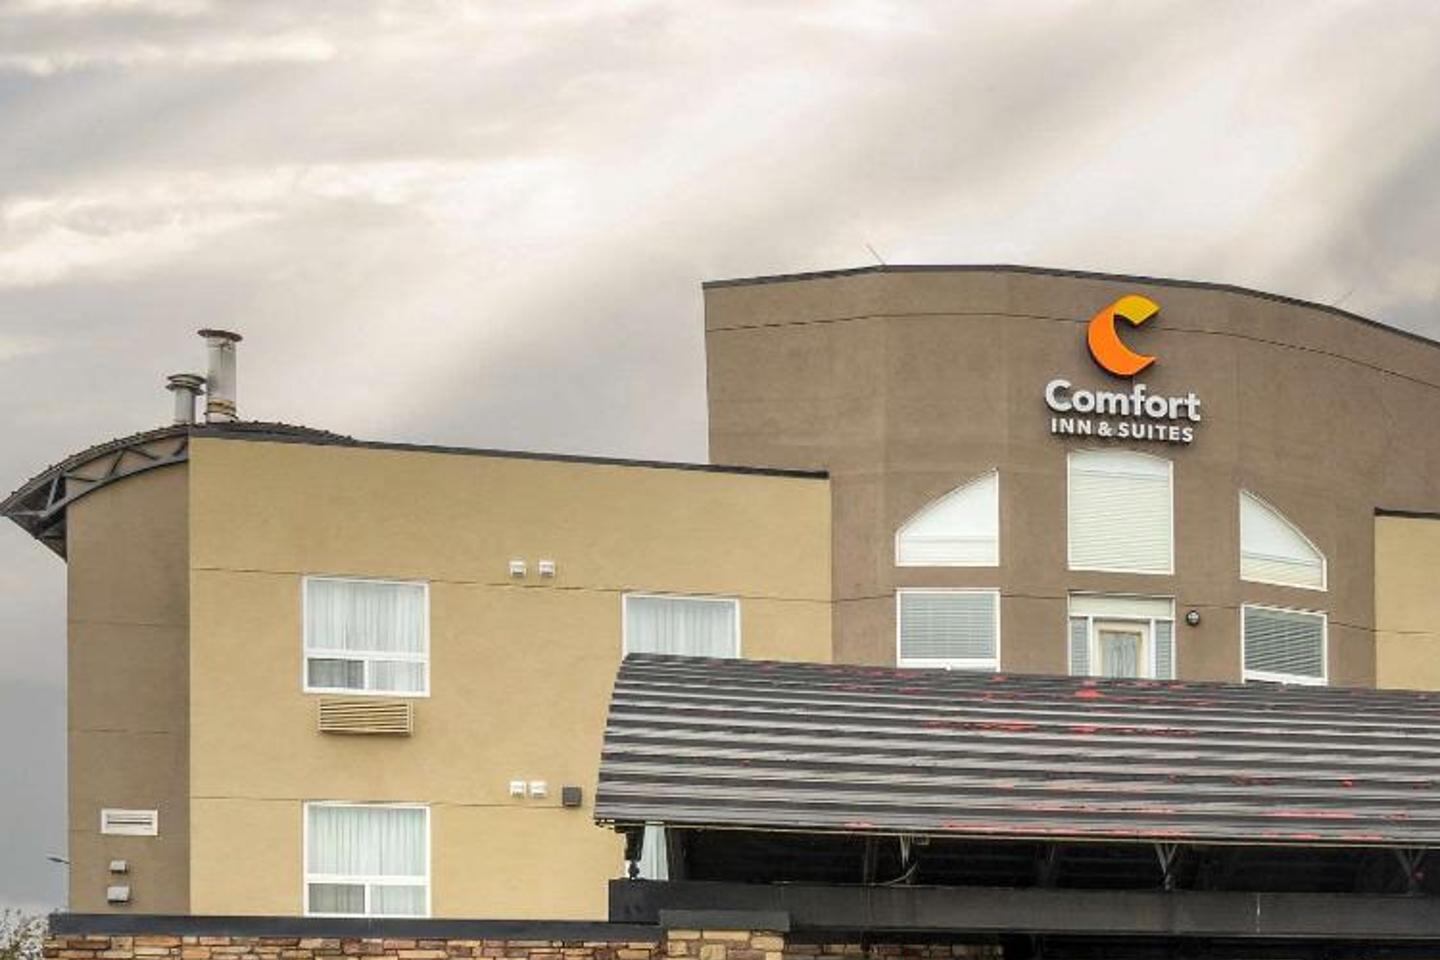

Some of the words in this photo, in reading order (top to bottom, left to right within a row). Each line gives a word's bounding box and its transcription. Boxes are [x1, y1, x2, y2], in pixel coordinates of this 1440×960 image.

[1045, 379, 1201, 422] Comfort
[1051, 418, 1092, 434] INN
[1097, 421, 1113, 437] &
[1118, 422, 1194, 443] SUITES
